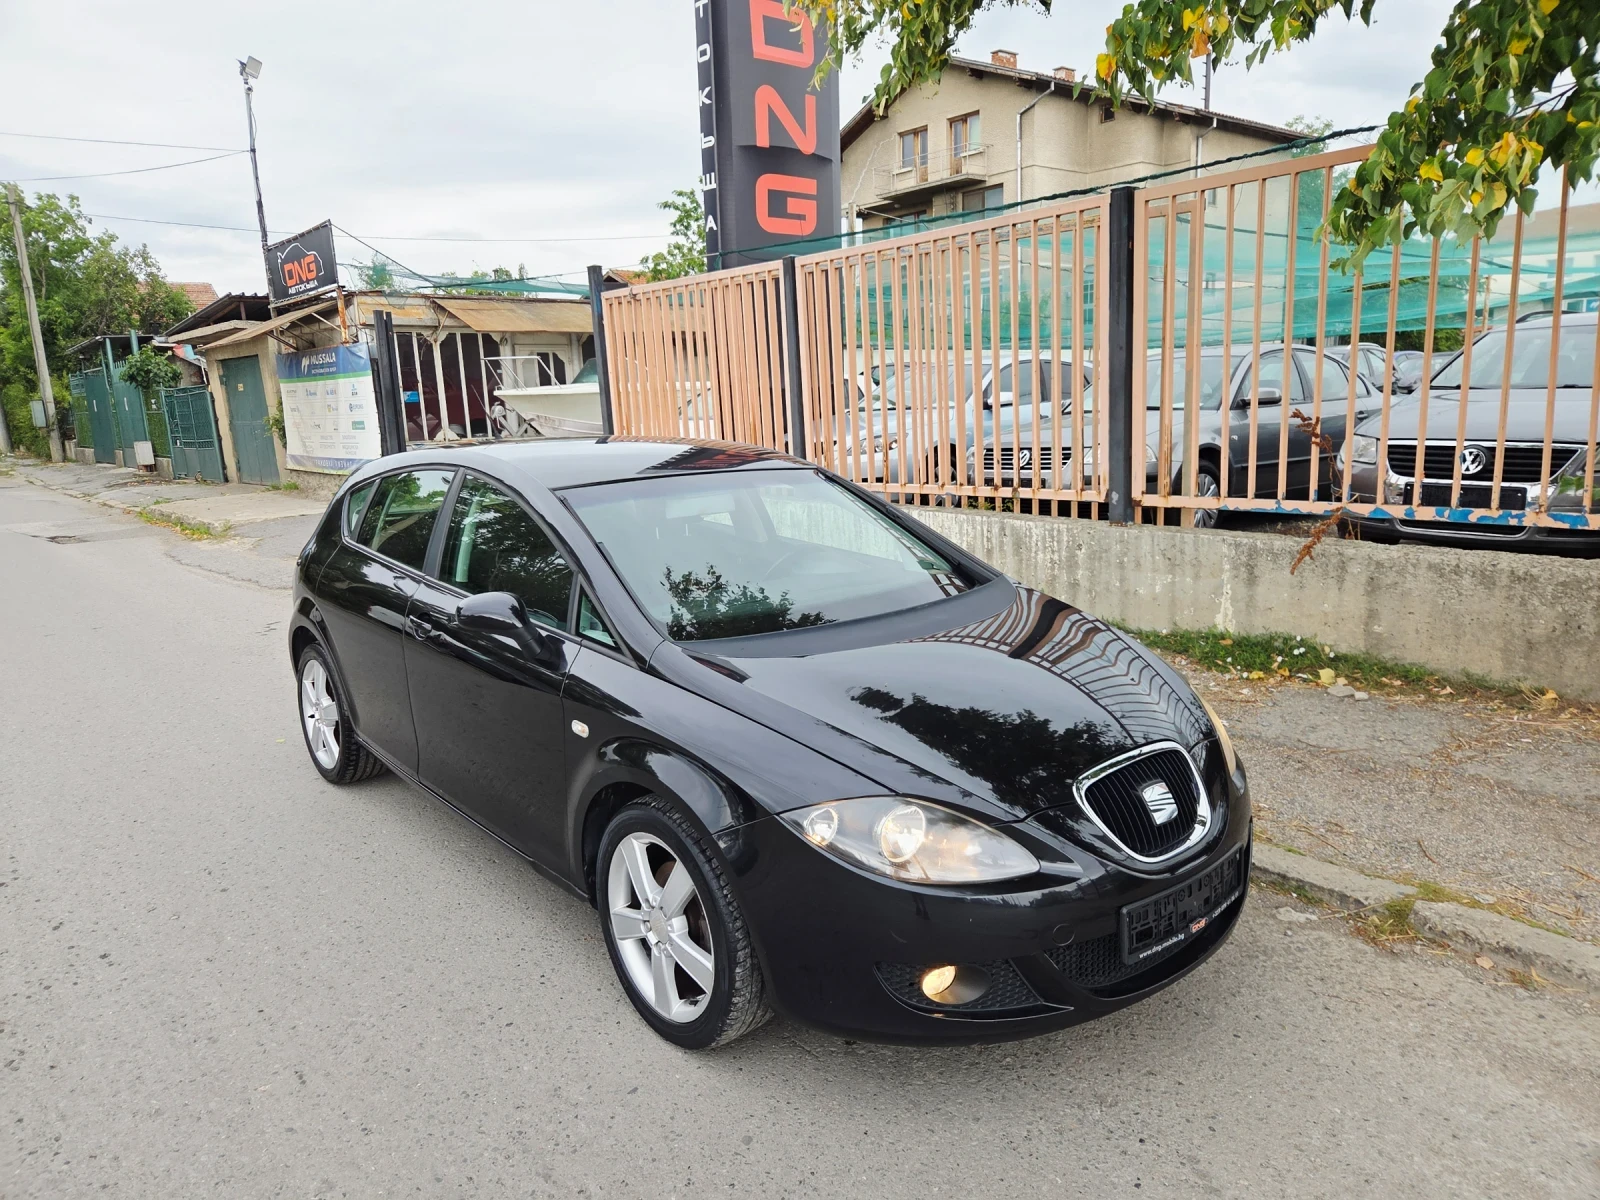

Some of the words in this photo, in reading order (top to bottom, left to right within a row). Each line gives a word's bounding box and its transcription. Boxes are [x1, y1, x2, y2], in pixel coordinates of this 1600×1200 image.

[749, 0, 817, 236] DNG
[283, 254, 317, 287] DNG
[310, 351, 336, 365] MUSSALA
